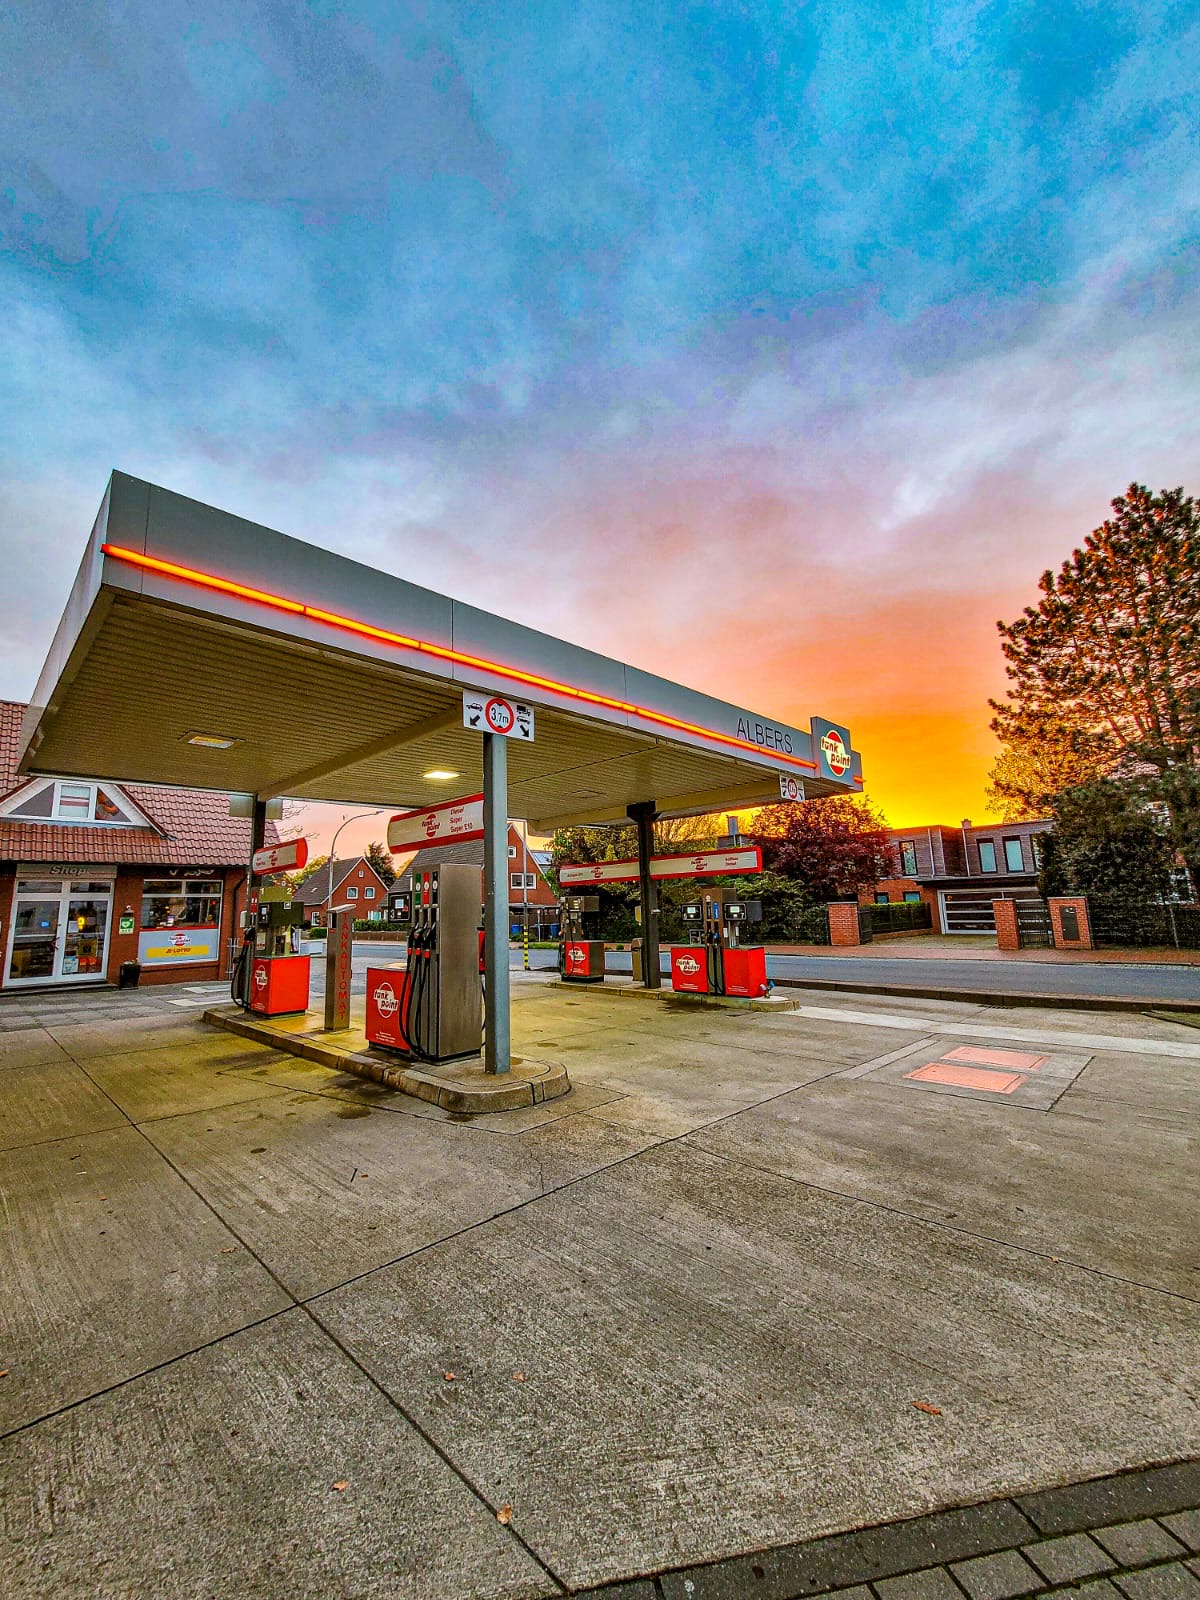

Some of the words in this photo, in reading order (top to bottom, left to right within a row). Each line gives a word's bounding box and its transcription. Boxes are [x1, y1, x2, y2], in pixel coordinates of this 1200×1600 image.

[737, 717, 793, 754] ALBERS
[821, 737, 839, 753] tank
[830, 753, 850, 767] point
[49, 864, 88, 877] Shop
[338, 911, 349, 1021] TANKAUTOMAT
[374, 990, 389, 1000] tank
[380, 999, 398, 1009] point
